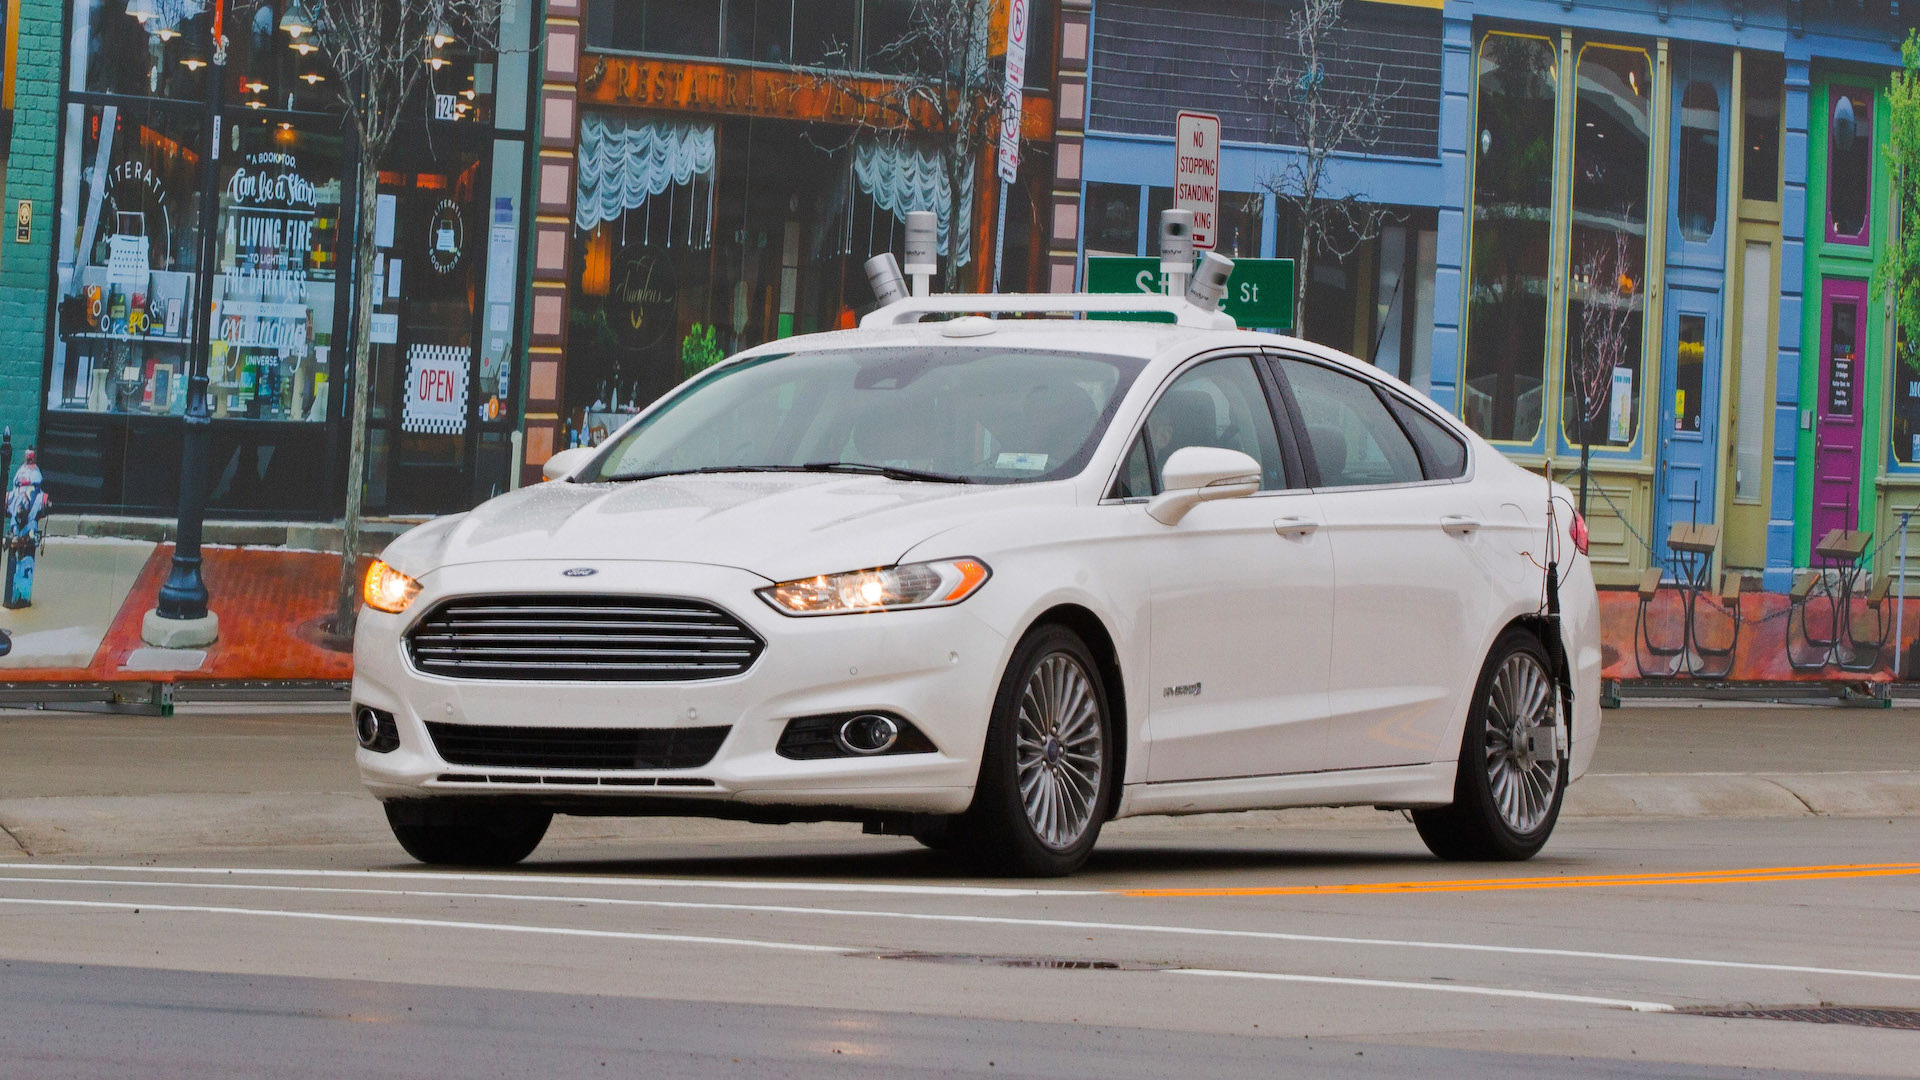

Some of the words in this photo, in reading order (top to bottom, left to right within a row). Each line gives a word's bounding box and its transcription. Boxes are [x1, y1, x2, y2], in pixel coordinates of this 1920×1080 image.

[616, 59, 797, 112] RESTAURANT
[437, 96, 455, 118] 124
[1193, 131, 1204, 148] NO
[1180, 156, 1215, 176] STOPPING
[226, 167, 257, 203] Can
[255, 170, 274, 203] be
[1179, 183, 1214, 203] STANDING
[1193, 211, 1211, 230] KING
[226, 215, 235, 245] A
[240, 215, 281, 249] LIVING
[285, 219, 314, 252] FIRE
[249, 253, 259, 264] TO
[260, 254, 289, 265] LIGHTEN
[224, 266, 245, 293] THE
[1240, 282, 1259, 302] St
[220, 315, 307, 373] expnding
[419, 368, 455, 403] OPEN
